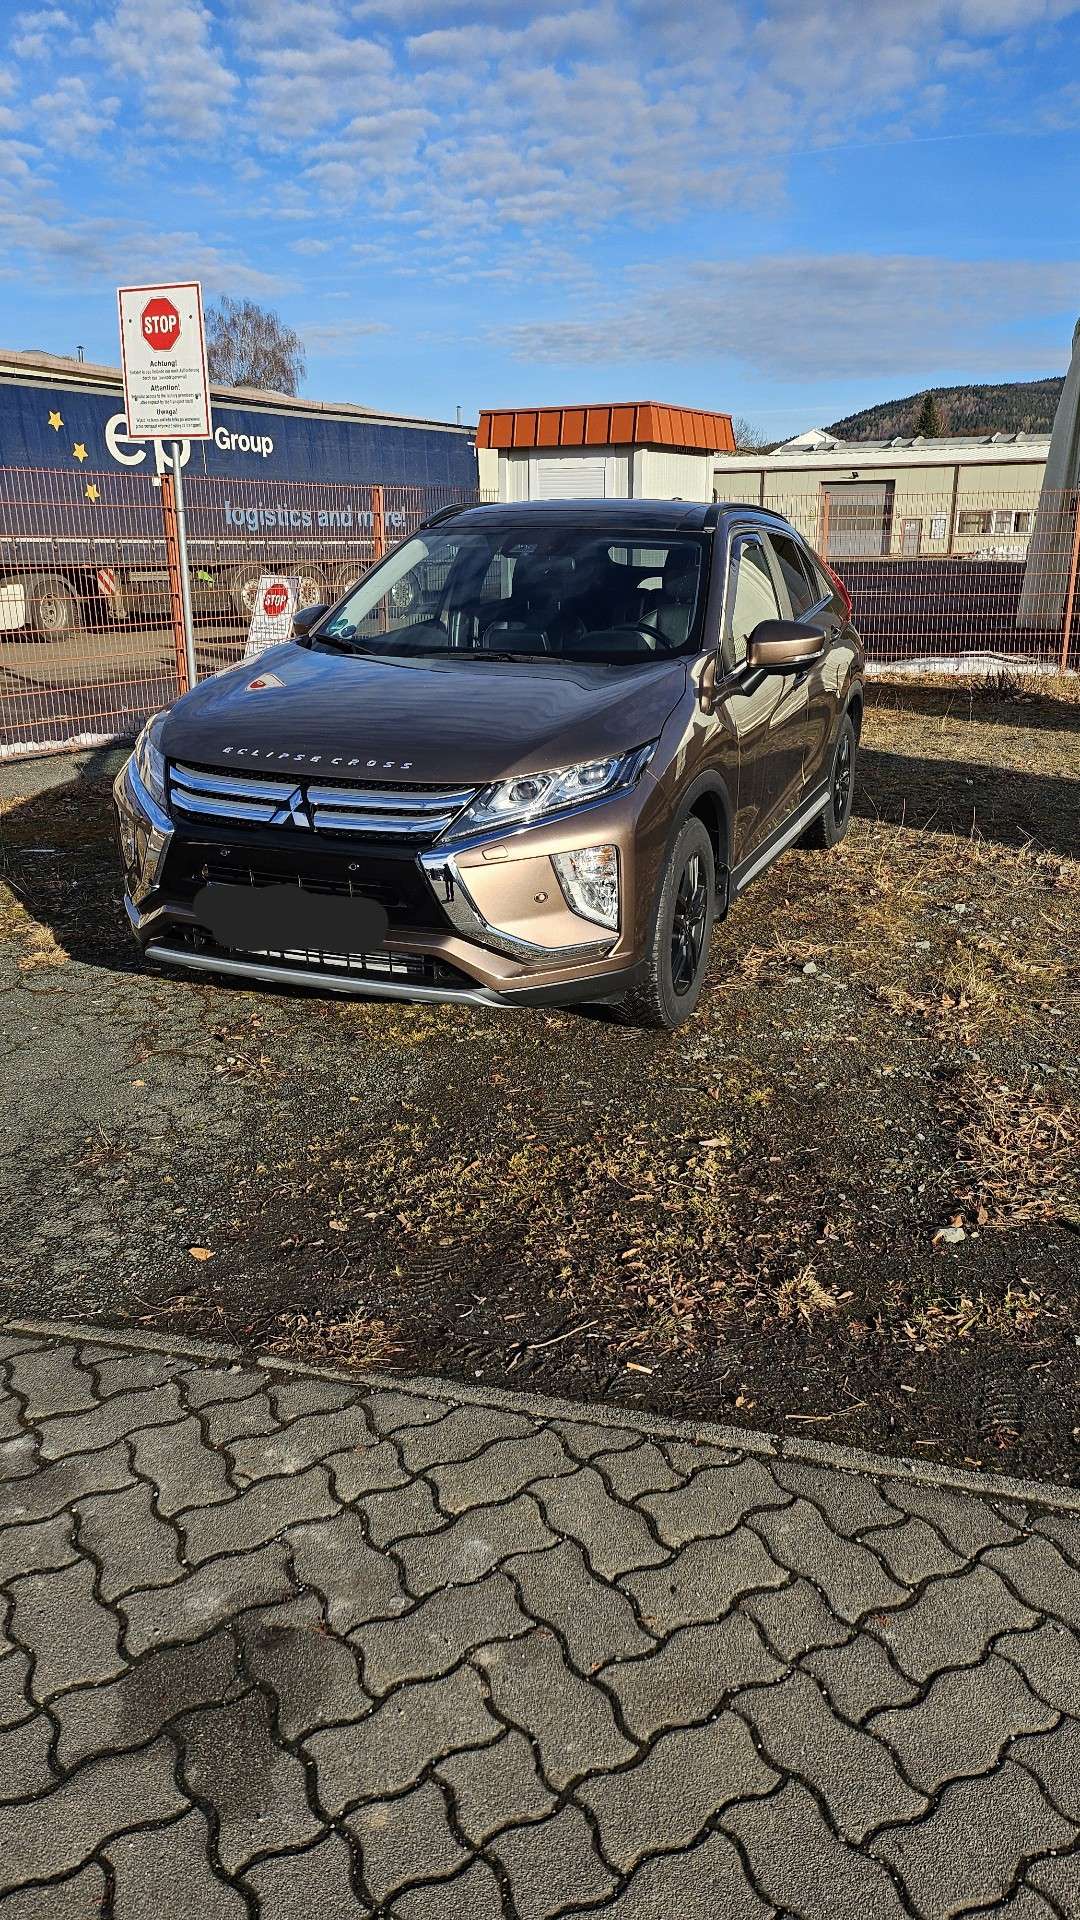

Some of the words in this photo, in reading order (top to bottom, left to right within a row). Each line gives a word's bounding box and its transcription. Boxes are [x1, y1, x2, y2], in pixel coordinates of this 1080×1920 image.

[144, 314, 177, 334] STOP
[149, 360, 178, 368] Achtung!
[150, 383, 181, 392] Attention!
[214, 426, 274, 458] Group
[224, 500, 312, 531] logistics
[319, 505, 352, 527] and
[358, 506, 407, 528] mre!
[264, 594, 287, 606] STOP
[222, 746, 322, 762] ECLIPSE
[331, 757, 413, 769] CROSS
